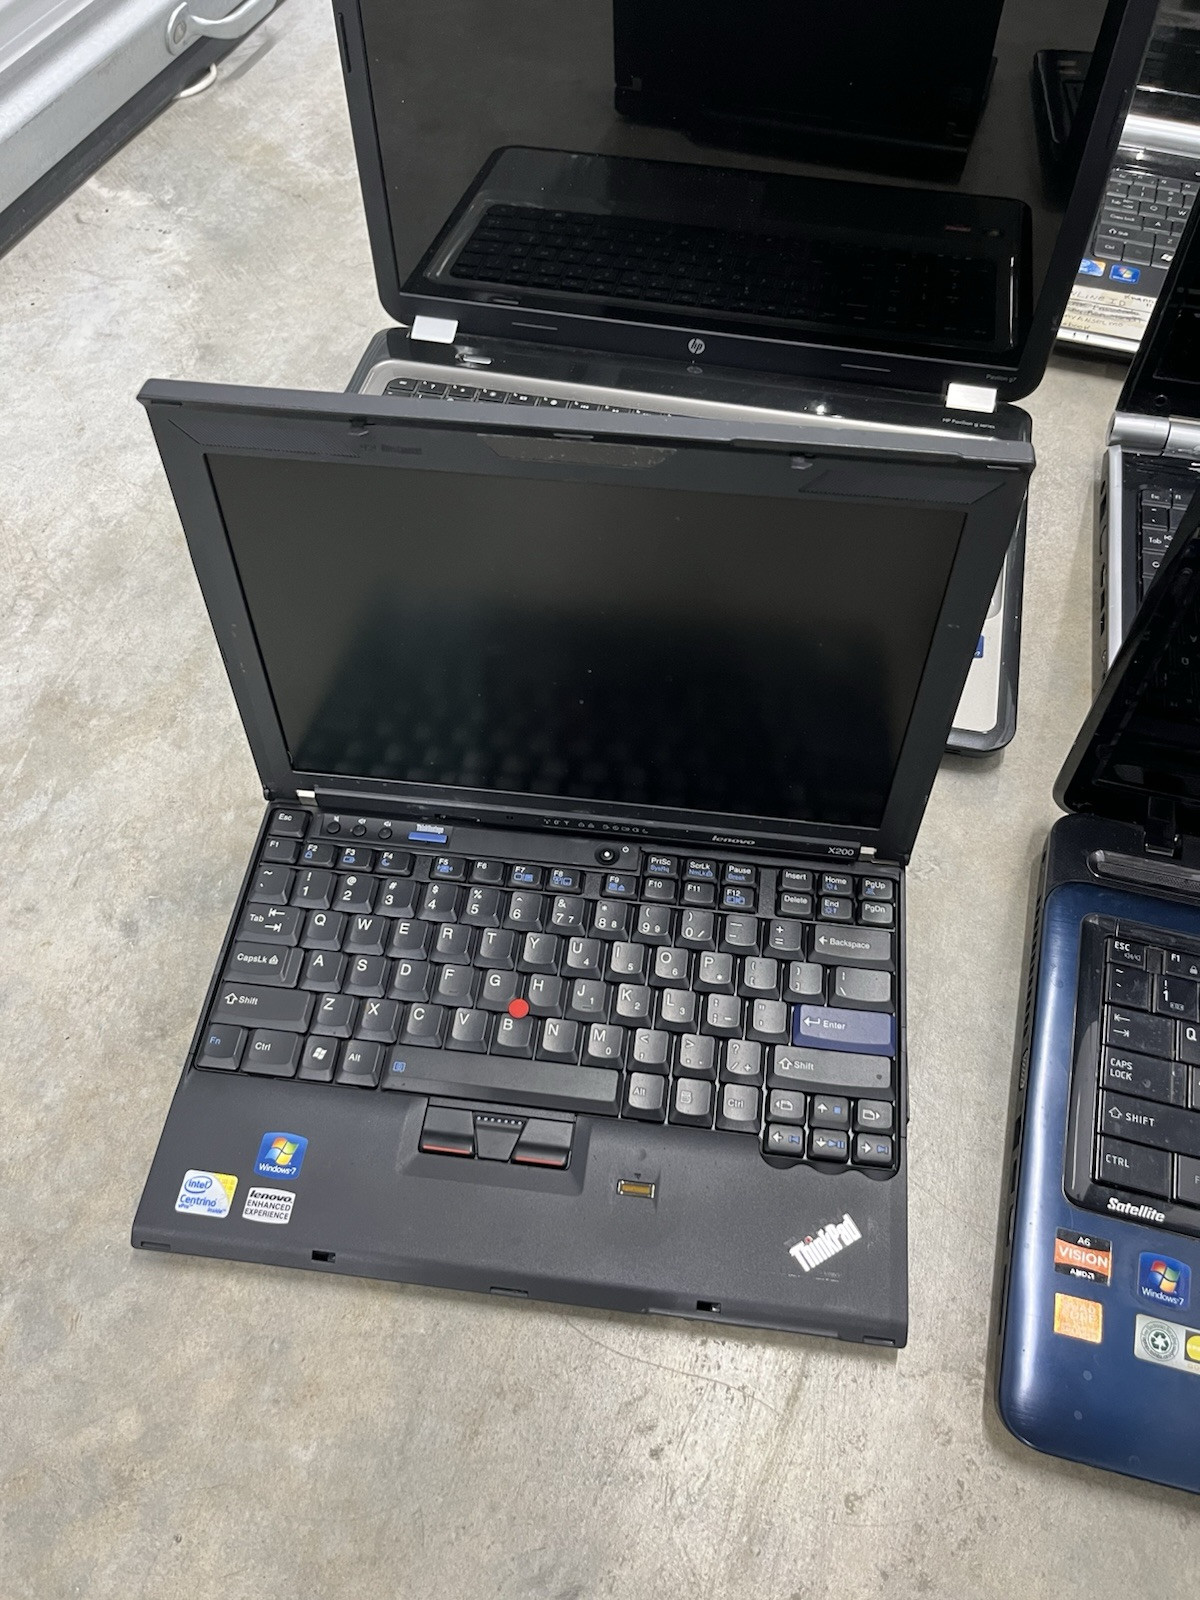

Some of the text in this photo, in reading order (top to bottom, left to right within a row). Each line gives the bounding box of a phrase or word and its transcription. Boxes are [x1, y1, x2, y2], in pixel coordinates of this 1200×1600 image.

[1149, 536, 1162, 545] Tab
[278, 813, 293, 822] Esc
[270, 841, 279, 849] F1
[712, 835, 755, 845] lenovo
[307, 844, 318, 852] F2
[345, 848, 356, 857] F3
[828, 847, 854, 856] X200
[383, 852, 394, 860] F4
[438, 857, 449, 866] F5
[651, 857, 672, 866] PrtSc
[476, 861, 487, 870] F6
[515, 865, 526, 874] F7
[690, 861, 710, 870] ScrLk
[728, 865, 752, 875] Pause
[553, 870, 564, 878] F8
[609, 875, 620, 884] F9
[785, 871, 807, 881] Insert
[347, 876, 357, 886] @
[389, 881, 397, 891] #
[648, 880, 663, 889] F10
[825, 875, 847, 886] Home
[865, 879, 886, 891] PgUp
[303, 886, 309, 896] 1
[687, 884, 701, 893] F11
[727, 888, 741, 897] F12
[342, 890, 352, 901] 2
[385, 895, 394, 905] 3
[784, 894, 808, 905] Delete
[427, 899, 437, 910] 4
[470, 904, 479, 915] 5
[824, 900, 840, 909] End
[864, 903, 886, 914] PgDn
[249, 913, 264, 924] Tab
[512, 908, 521, 919] 6
[556, 913, 565, 923] 7
[314, 914, 327, 926] Q
[357, 919, 372, 931] W
[598, 917, 607, 928] 8
[398, 923, 410, 935] E
[642, 922, 651, 933] 9
[442, 927, 453, 940] R
[487, 932, 498, 944] T
[529, 937, 540, 949] Y
[572, 942, 583, 954] U
[829, 937, 871, 950] Backspace
[1114, 940, 1131, 951] ESC
[237, 952, 268, 966] CapsLk
[312, 955, 324, 967] A
[660, 952, 672, 964] O
[704, 956, 714, 968] P
[1171, 953, 1181, 962] F1
[356, 959, 367, 971] S
[400, 964, 412, 976] D
[444, 969, 455, 980] F
[489, 974, 501, 987] G
[533, 979, 544, 992] H
[577, 984, 586, 996] J
[622, 989, 632, 1002] K
[238, 995, 258, 1006] Shift
[323, 998, 335, 1011] Z
[666, 994, 675, 1007] L
[368, 1002, 380, 1016] X
[413, 1008, 424, 1021] C
[459, 1012, 471, 1026] V
[502, 1018, 513, 1031] B
[548, 1024, 559, 1036] N
[823, 1019, 846, 1031] Enter
[593, 1029, 606, 1042] M
[1186, 1027, 1197, 1041] Q
[209, 1035, 221, 1045] Fn
[255, 1041, 271, 1052] Ctrl
[349, 1052, 361, 1063] Alt
[793, 1061, 814, 1071] Shift
[1110, 1058, 1133, 1071] CAPS
[1110, 1069, 1133, 1081] LOCK
[633, 1086, 646, 1097] Alt
[727, 1099, 744, 1108] Ctrl
[1125, 1112, 1155, 1127] SHIFT
[1105, 1154, 1130, 1168] CTRL
[259, 1163, 290, 1174] Windows
[180, 1194, 217, 1208] Centrino
[250, 1190, 292, 1202] lenovo
[247, 1200, 291, 1212] ENHANCED
[1107, 1197, 1166, 1222] Satellite
[244, 1208, 289, 1220] EXPERIENCE
[789, 1213, 862, 1272] ThinkPad
[1077, 1236, 1091, 1247] A6
[1058, 1246, 1108, 1269] VISION
[1141, 1286, 1178, 1304] Windows
